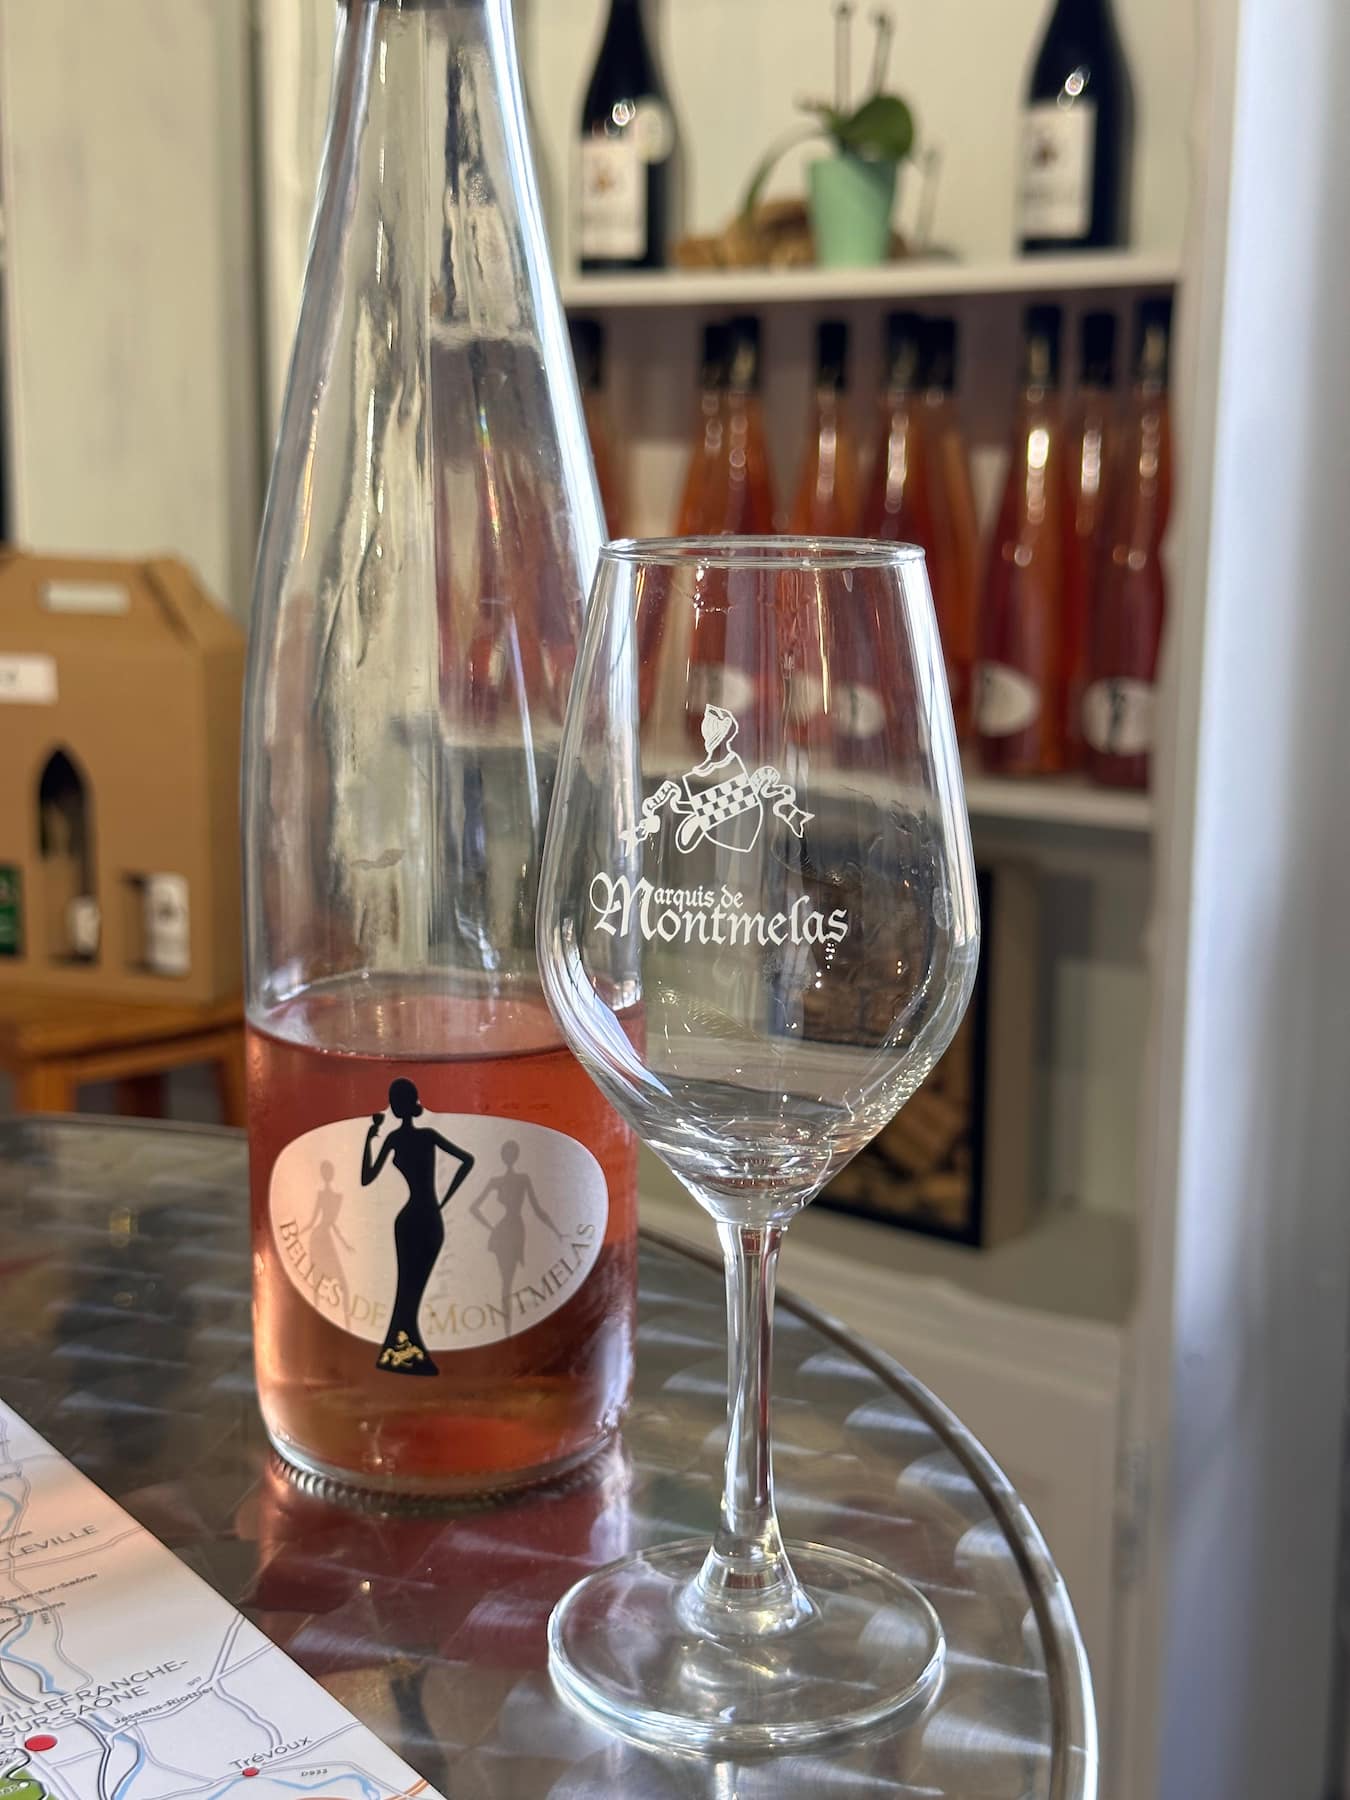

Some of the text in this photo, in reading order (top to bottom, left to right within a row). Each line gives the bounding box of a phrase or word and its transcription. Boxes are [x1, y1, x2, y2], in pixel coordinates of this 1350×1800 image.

[720, 884, 744, 909] de
[589, 893, 849, 946] Montmelas
[279, 1218, 342, 1308] BELLES
[350, 1292, 387, 1330] DE
[426, 1222, 596, 1336] MONTMELAS
[229, 1736, 312, 1770] Trévoux
